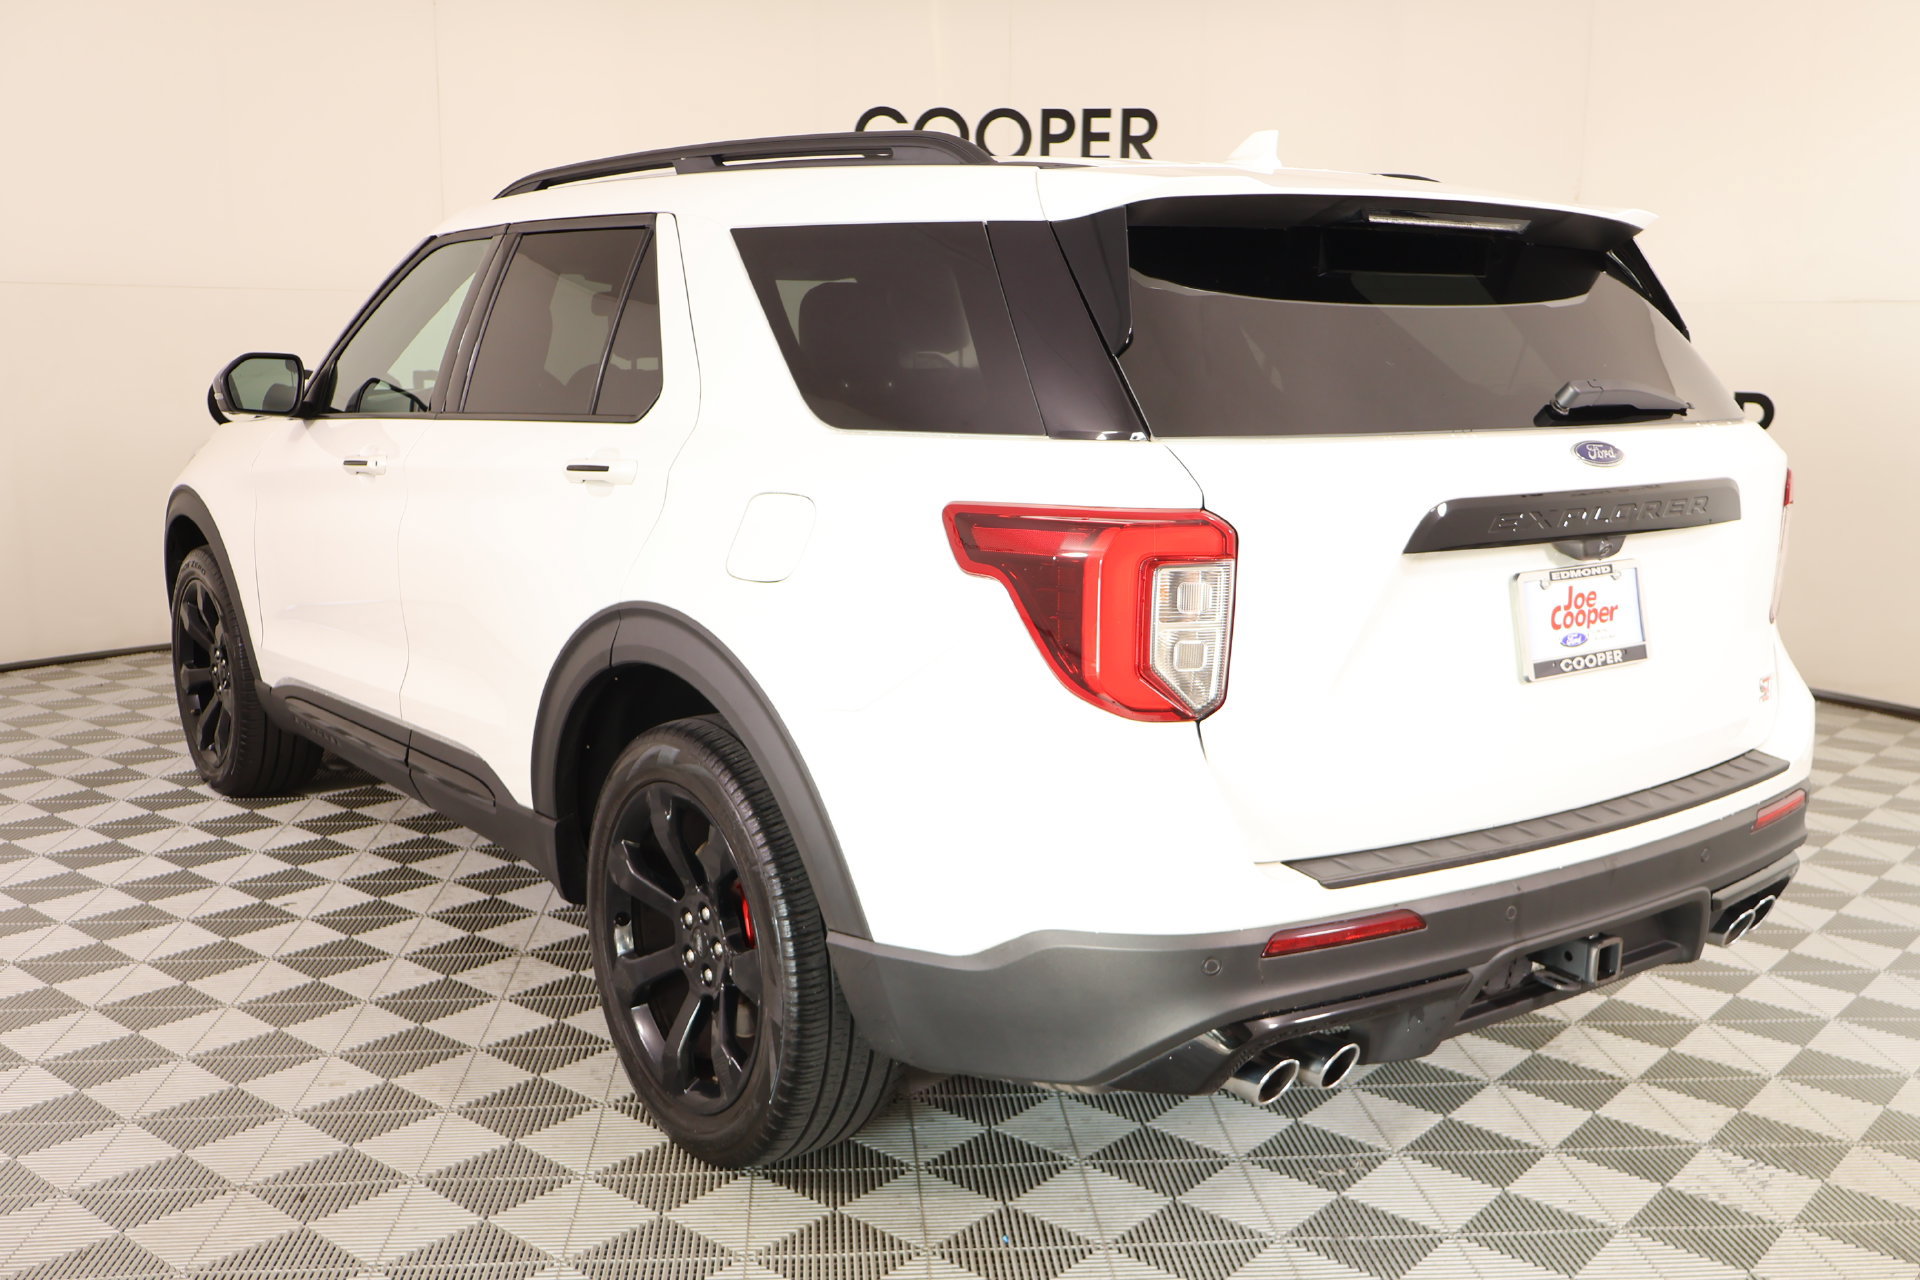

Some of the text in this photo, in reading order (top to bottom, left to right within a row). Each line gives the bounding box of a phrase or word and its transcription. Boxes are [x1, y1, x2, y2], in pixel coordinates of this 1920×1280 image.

[1585, 443, 1617, 460] Ford
[1488, 495, 1709, 533] EXPLORER
[1551, 565, 1611, 580] EDMOND
[1563, 586, 1597, 611] Joe
[1551, 604, 1618, 630] Cooper
[1560, 650, 1623, 672] COOPER
